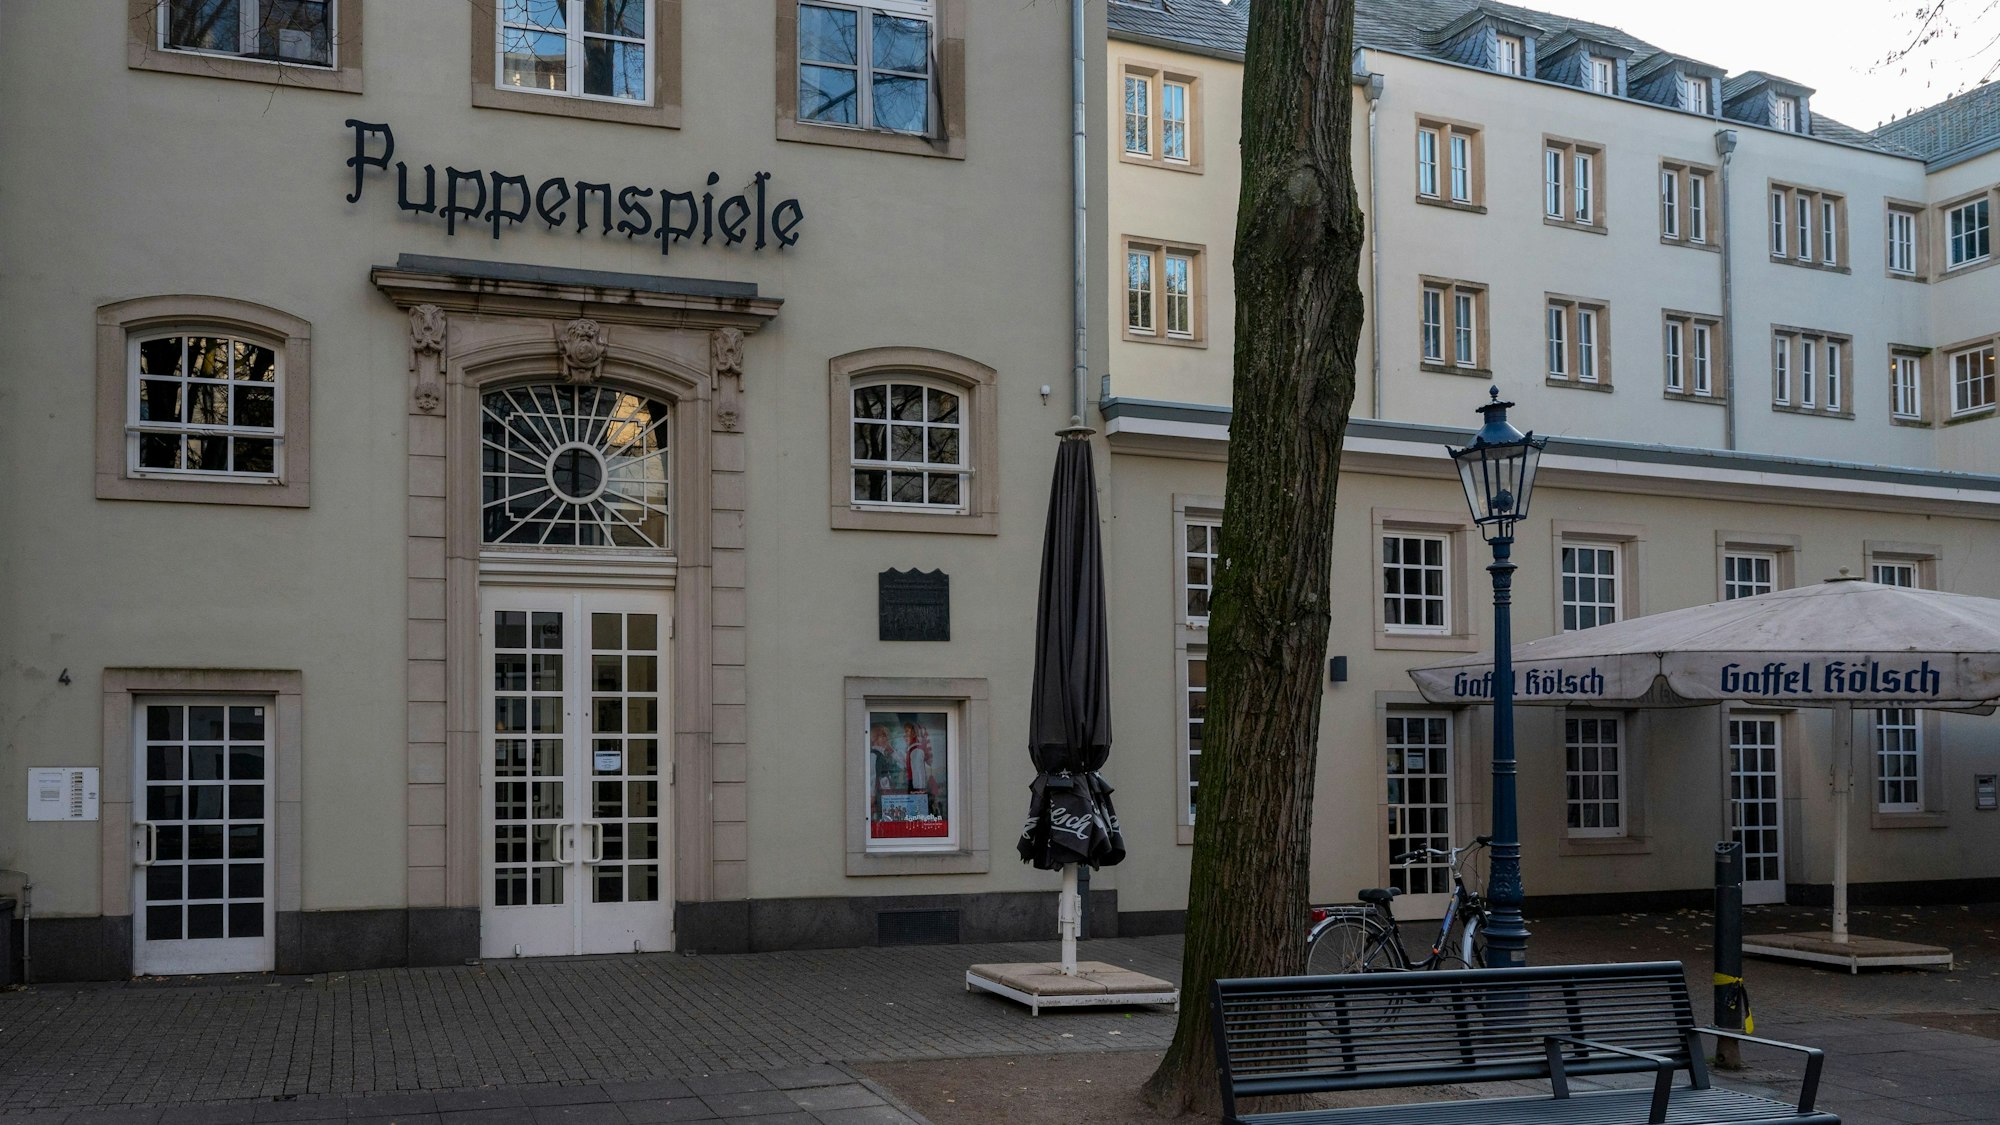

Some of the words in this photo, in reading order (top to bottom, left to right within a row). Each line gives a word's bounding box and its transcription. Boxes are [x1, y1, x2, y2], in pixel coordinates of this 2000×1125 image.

[345, 118, 804, 256] Puppenspiele
[58, 667, 72, 686] 4
[1454, 670, 1518, 699] Gaffl
[1525, 667, 1604, 696] Kölsch
[1721, 662, 1813, 696] Gaffel
[1824, 660, 1940, 696] Kölsch
